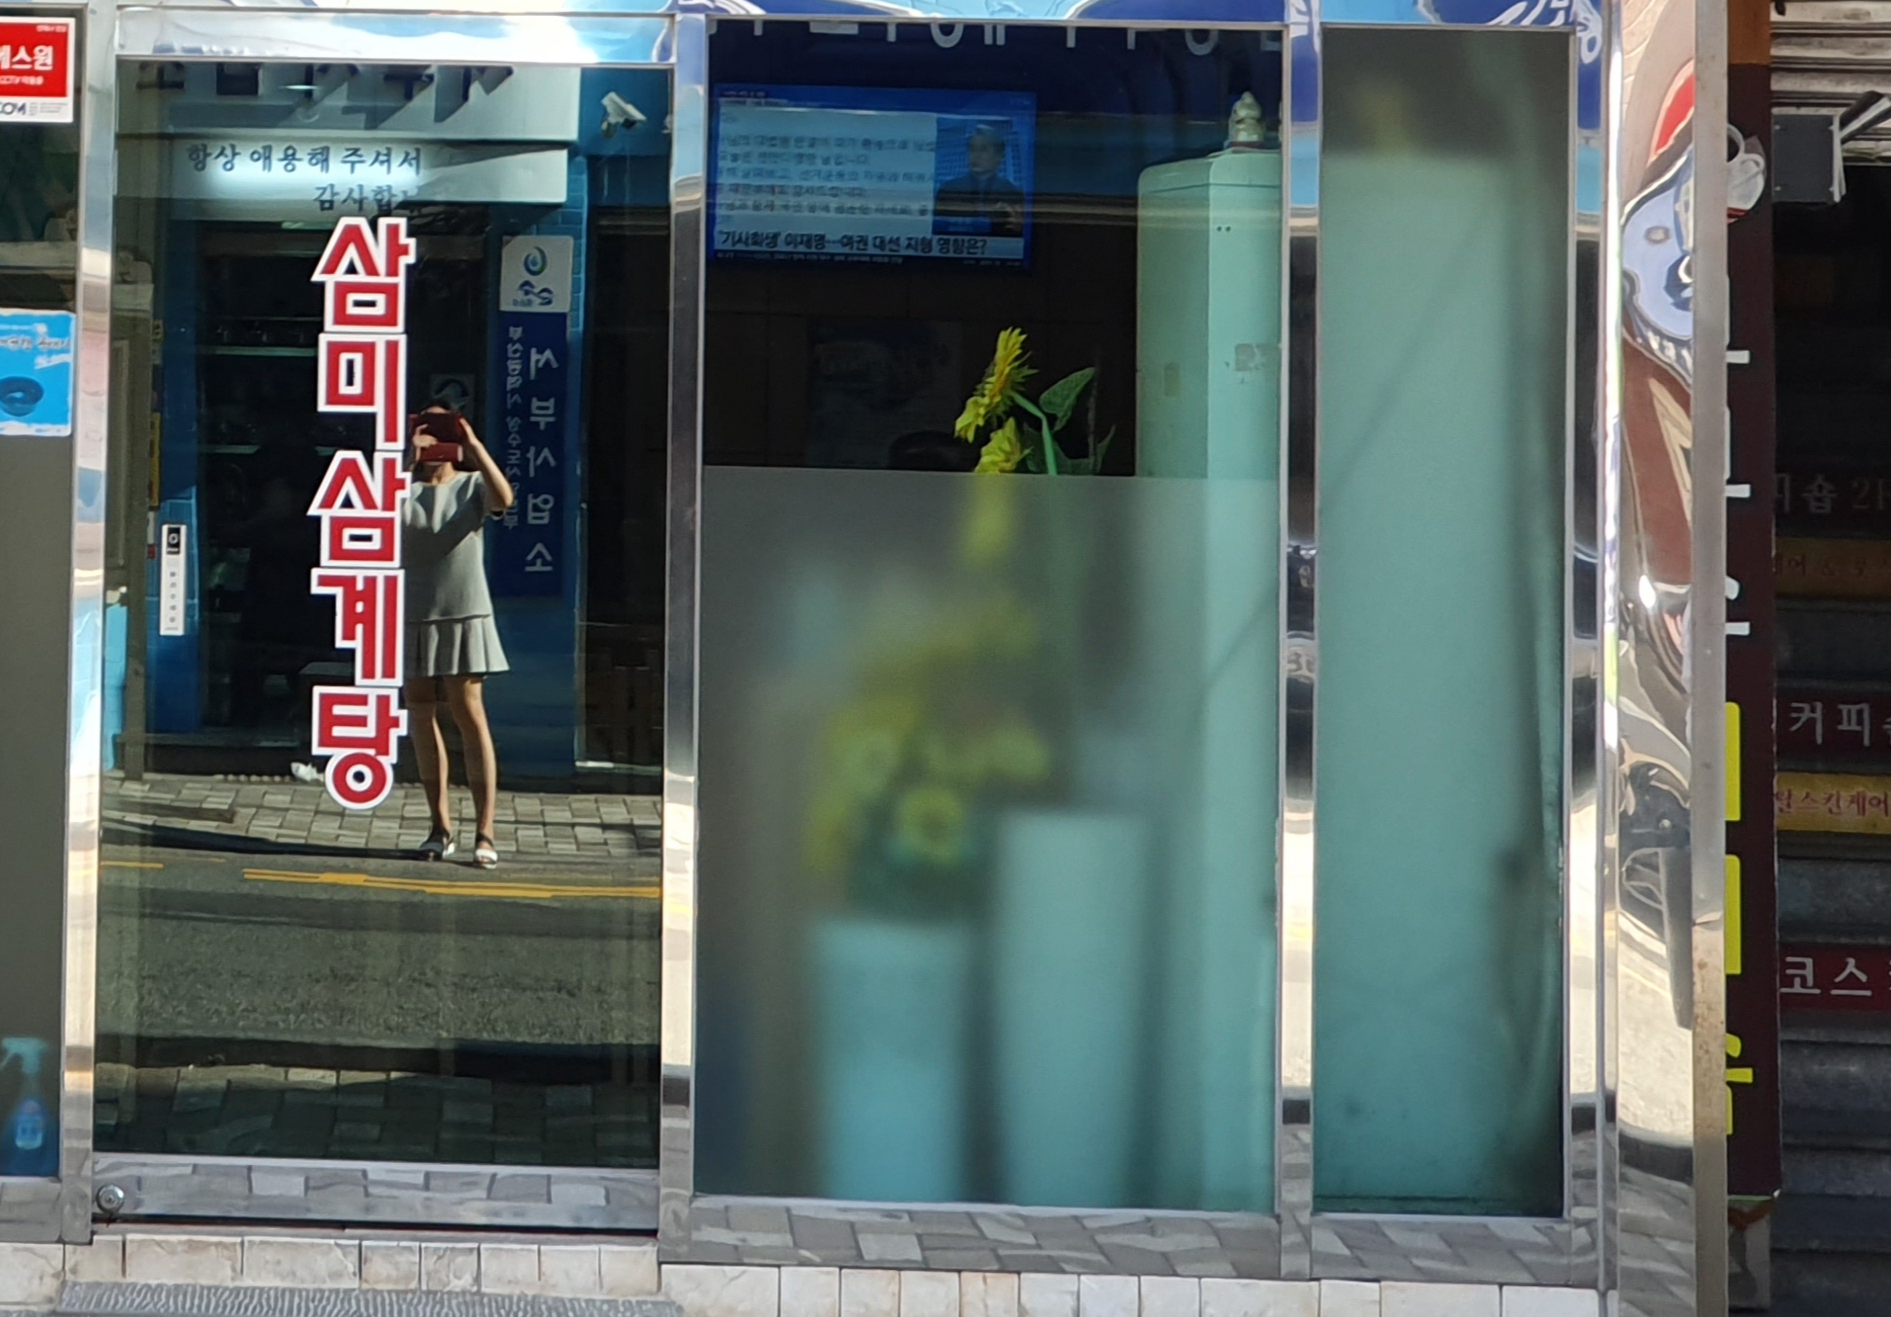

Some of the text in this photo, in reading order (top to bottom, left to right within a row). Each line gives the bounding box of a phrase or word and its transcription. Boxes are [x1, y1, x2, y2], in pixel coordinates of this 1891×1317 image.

[186, 143, 423, 176] 항상 애용해 주셔서
[306, 215, 417, 811] 삼미삼계탕
[1788, 701, 1891, 748] 커피
[1779, 956, 1891, 998] 코스
